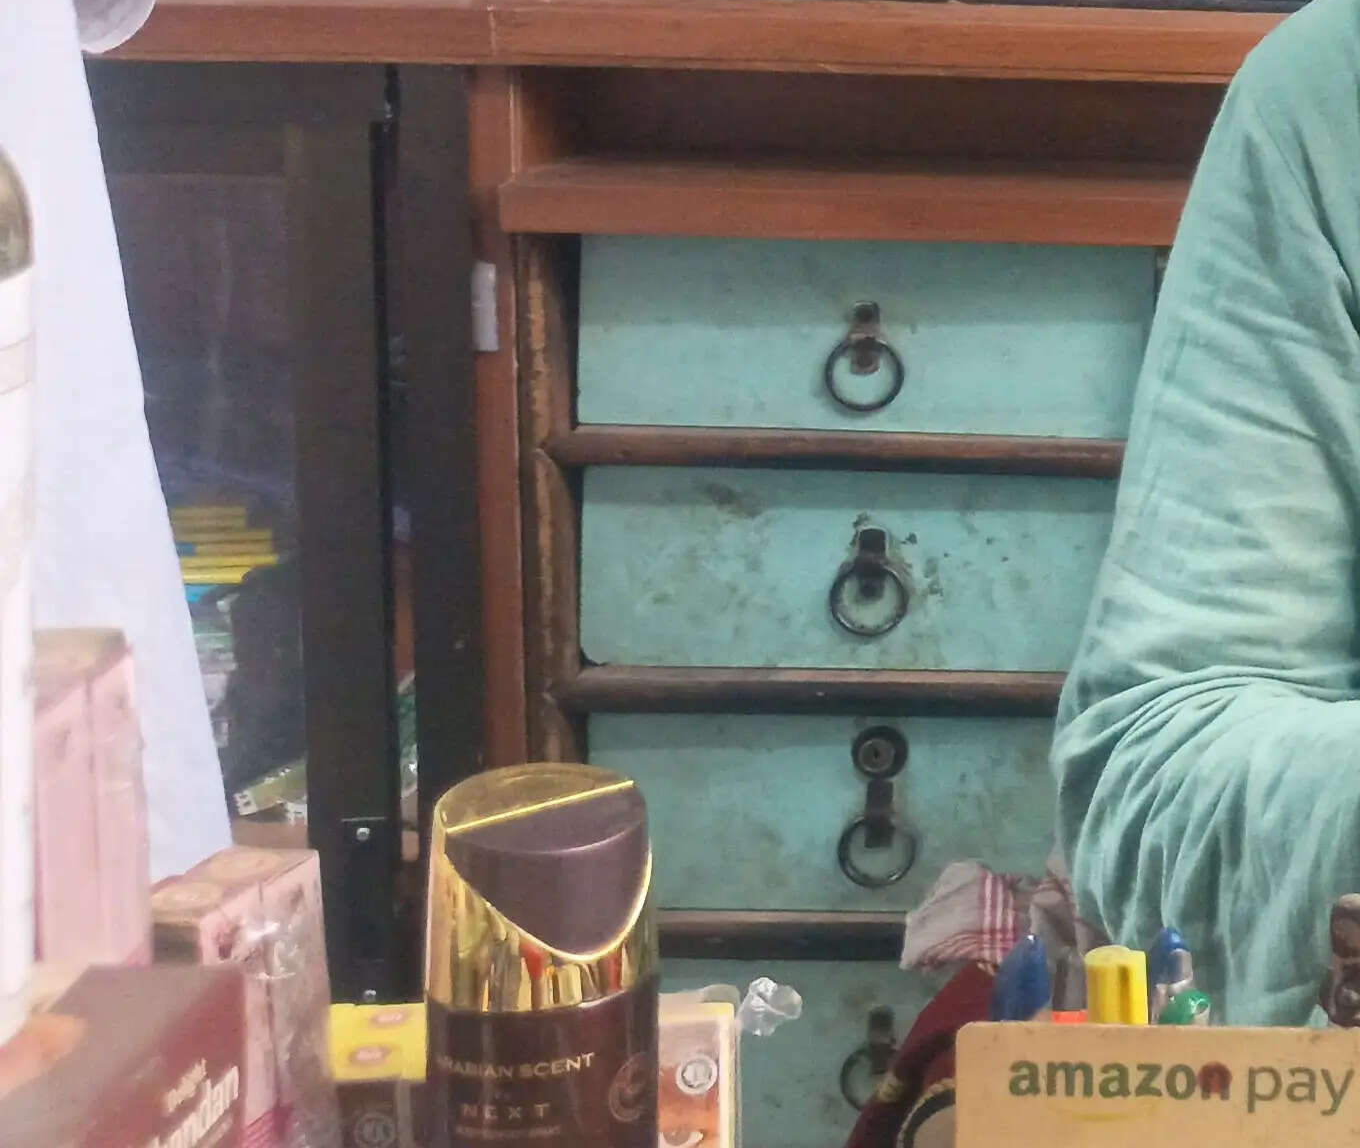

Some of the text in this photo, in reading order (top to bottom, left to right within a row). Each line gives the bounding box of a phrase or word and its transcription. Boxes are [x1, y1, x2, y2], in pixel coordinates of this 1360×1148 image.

[519, 1052, 596, 1078] SCENT
[1009, 1058, 1357, 1116] amazon pay
[461, 1103, 549, 1120] NEXT
